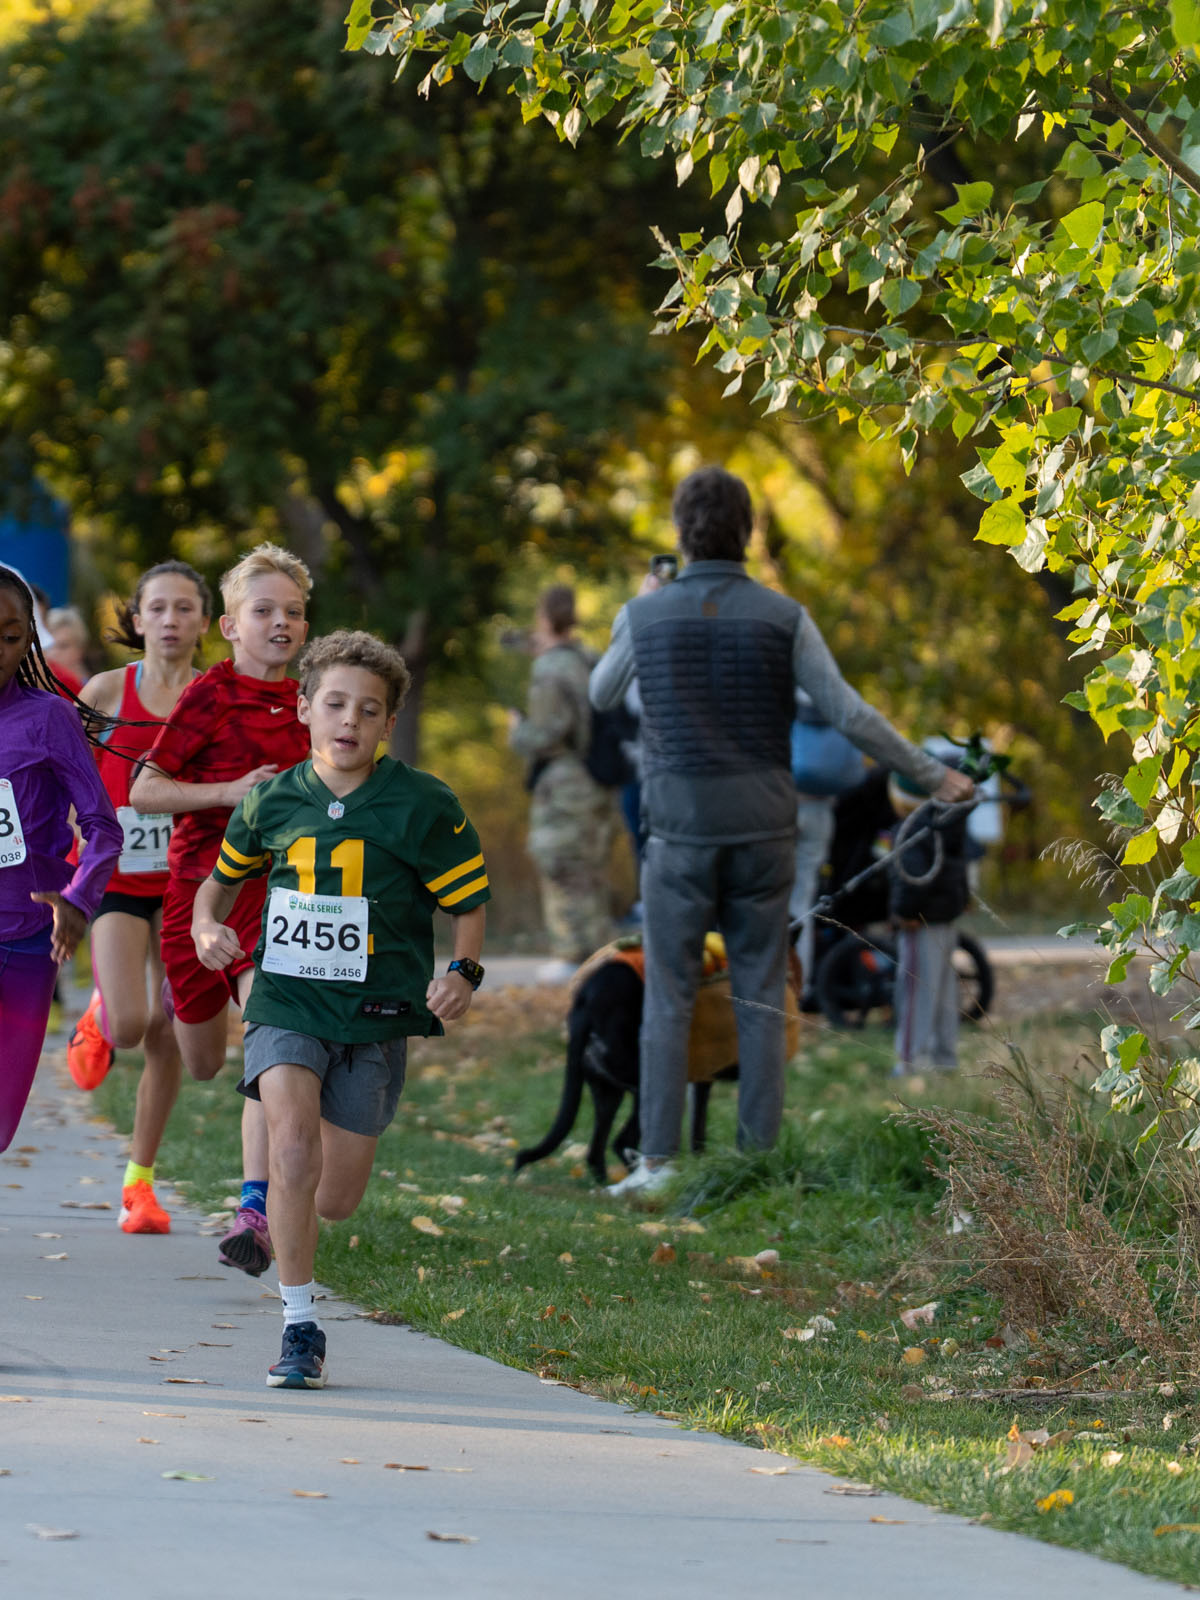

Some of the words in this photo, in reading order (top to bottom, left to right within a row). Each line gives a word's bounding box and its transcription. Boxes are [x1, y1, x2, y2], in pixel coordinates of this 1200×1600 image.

[129, 825, 171, 850] 211
[287, 837, 364, 897] 11
[298, 901, 315, 912] RACE
[316, 902, 343, 914] SERIES
[272, 915, 361, 952] 2456
[299, 965, 327, 976] 2456
[333, 967, 362, 978] 2456
